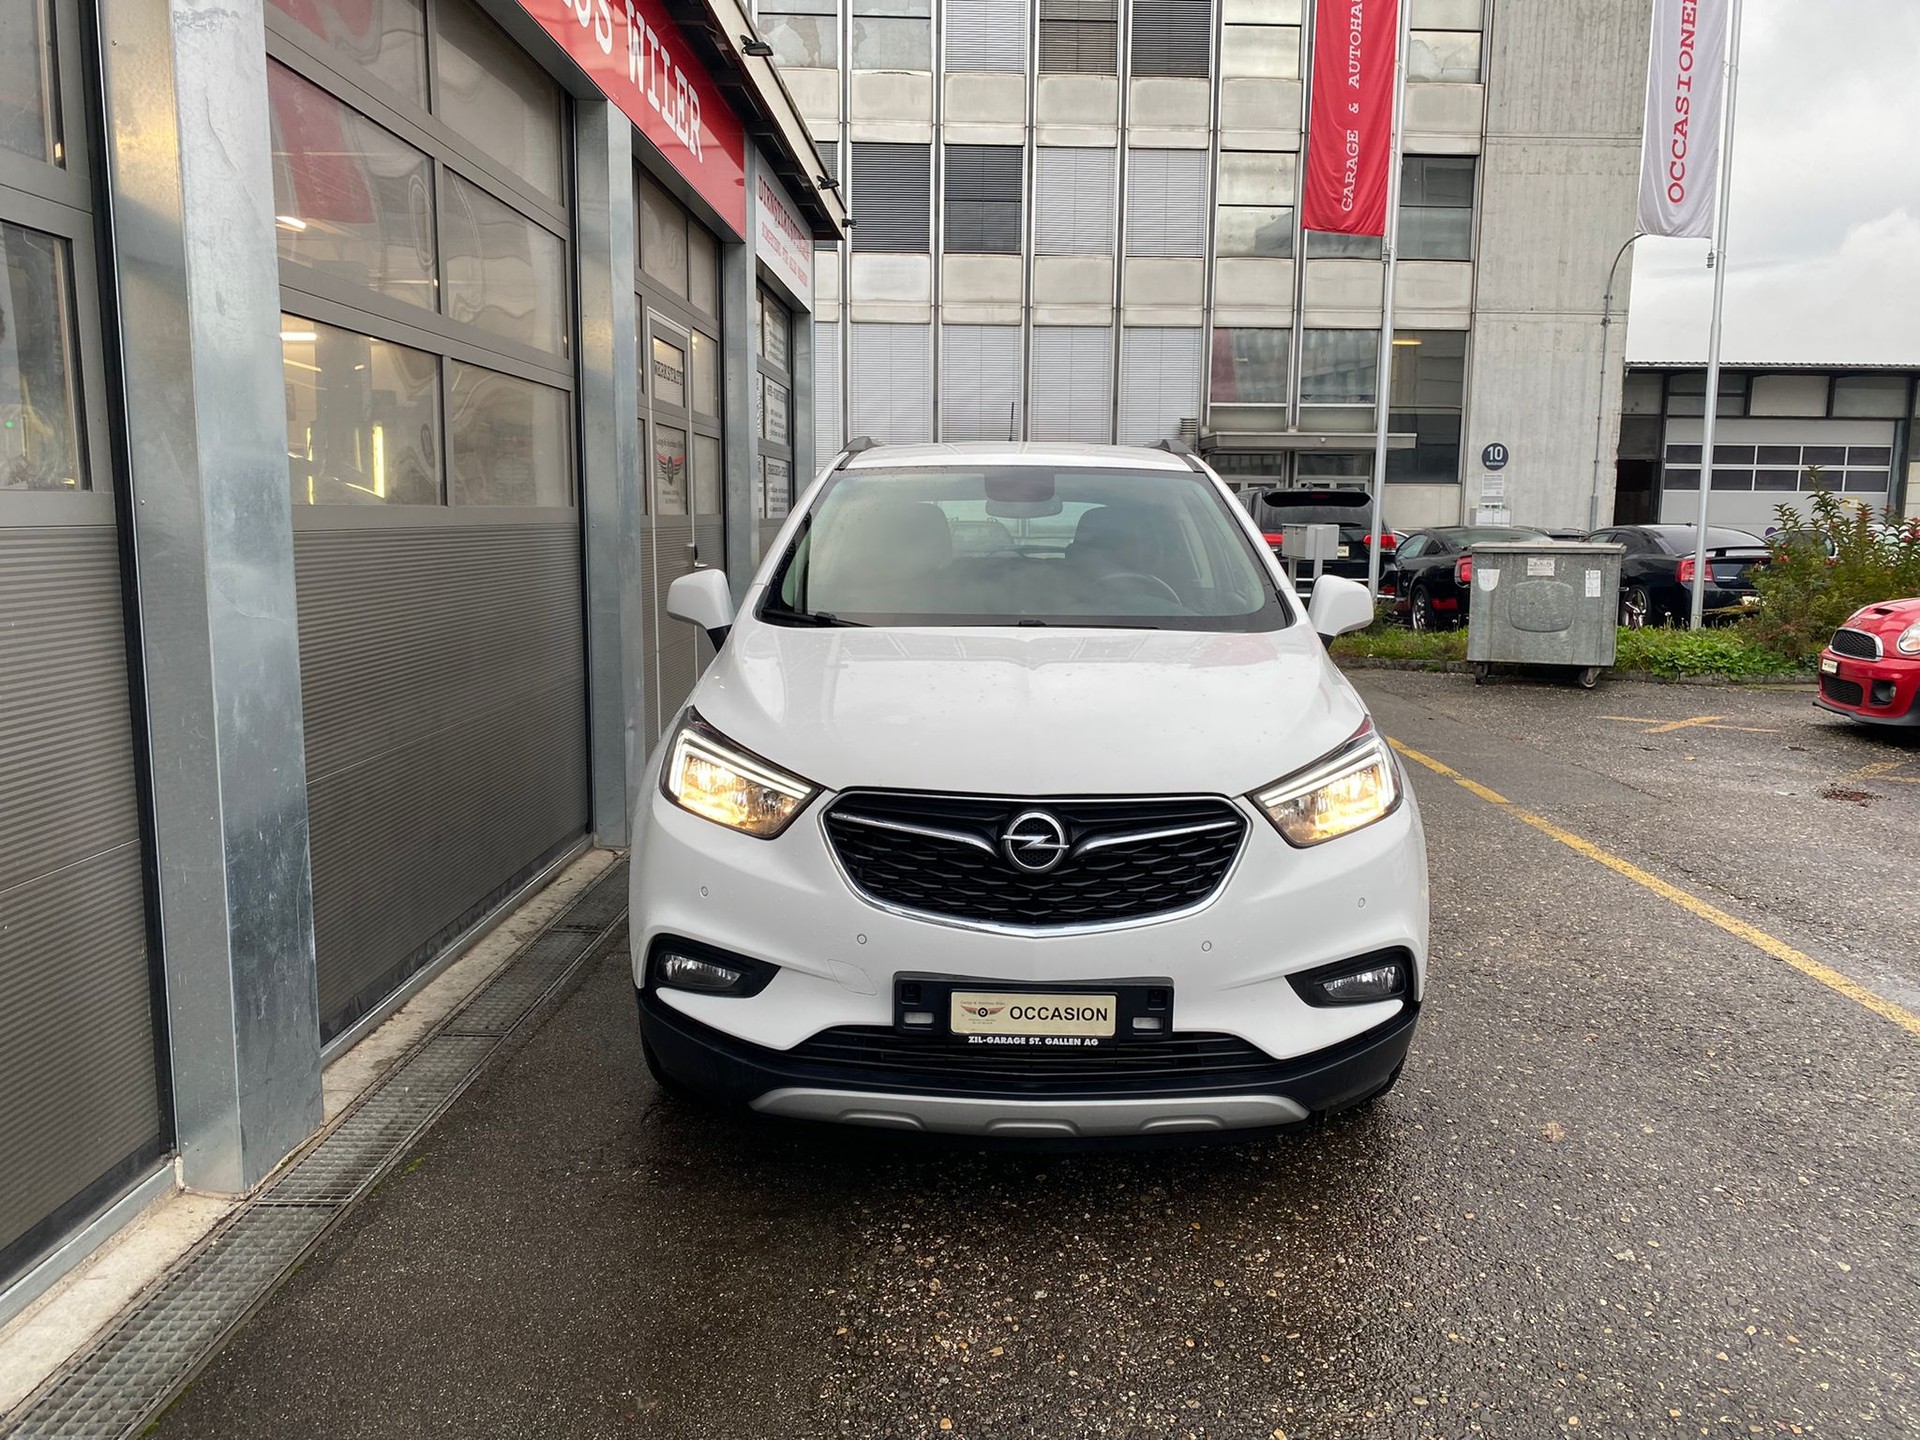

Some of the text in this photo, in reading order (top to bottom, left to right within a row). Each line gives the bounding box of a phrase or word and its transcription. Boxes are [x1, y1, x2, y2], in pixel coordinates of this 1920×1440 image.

[625, 0, 703, 164] WILER
[1341, 0, 1363, 212] GARAGE & AUTOHA
[1668, 0, 1697, 203] OCCASIONE
[1487, 446, 1503, 460] 10
[968, 1036, 1098, 1046] ZIL-GARAGE ST. GALLEN AG
[1009, 1006, 1108, 1021] OCCASION
